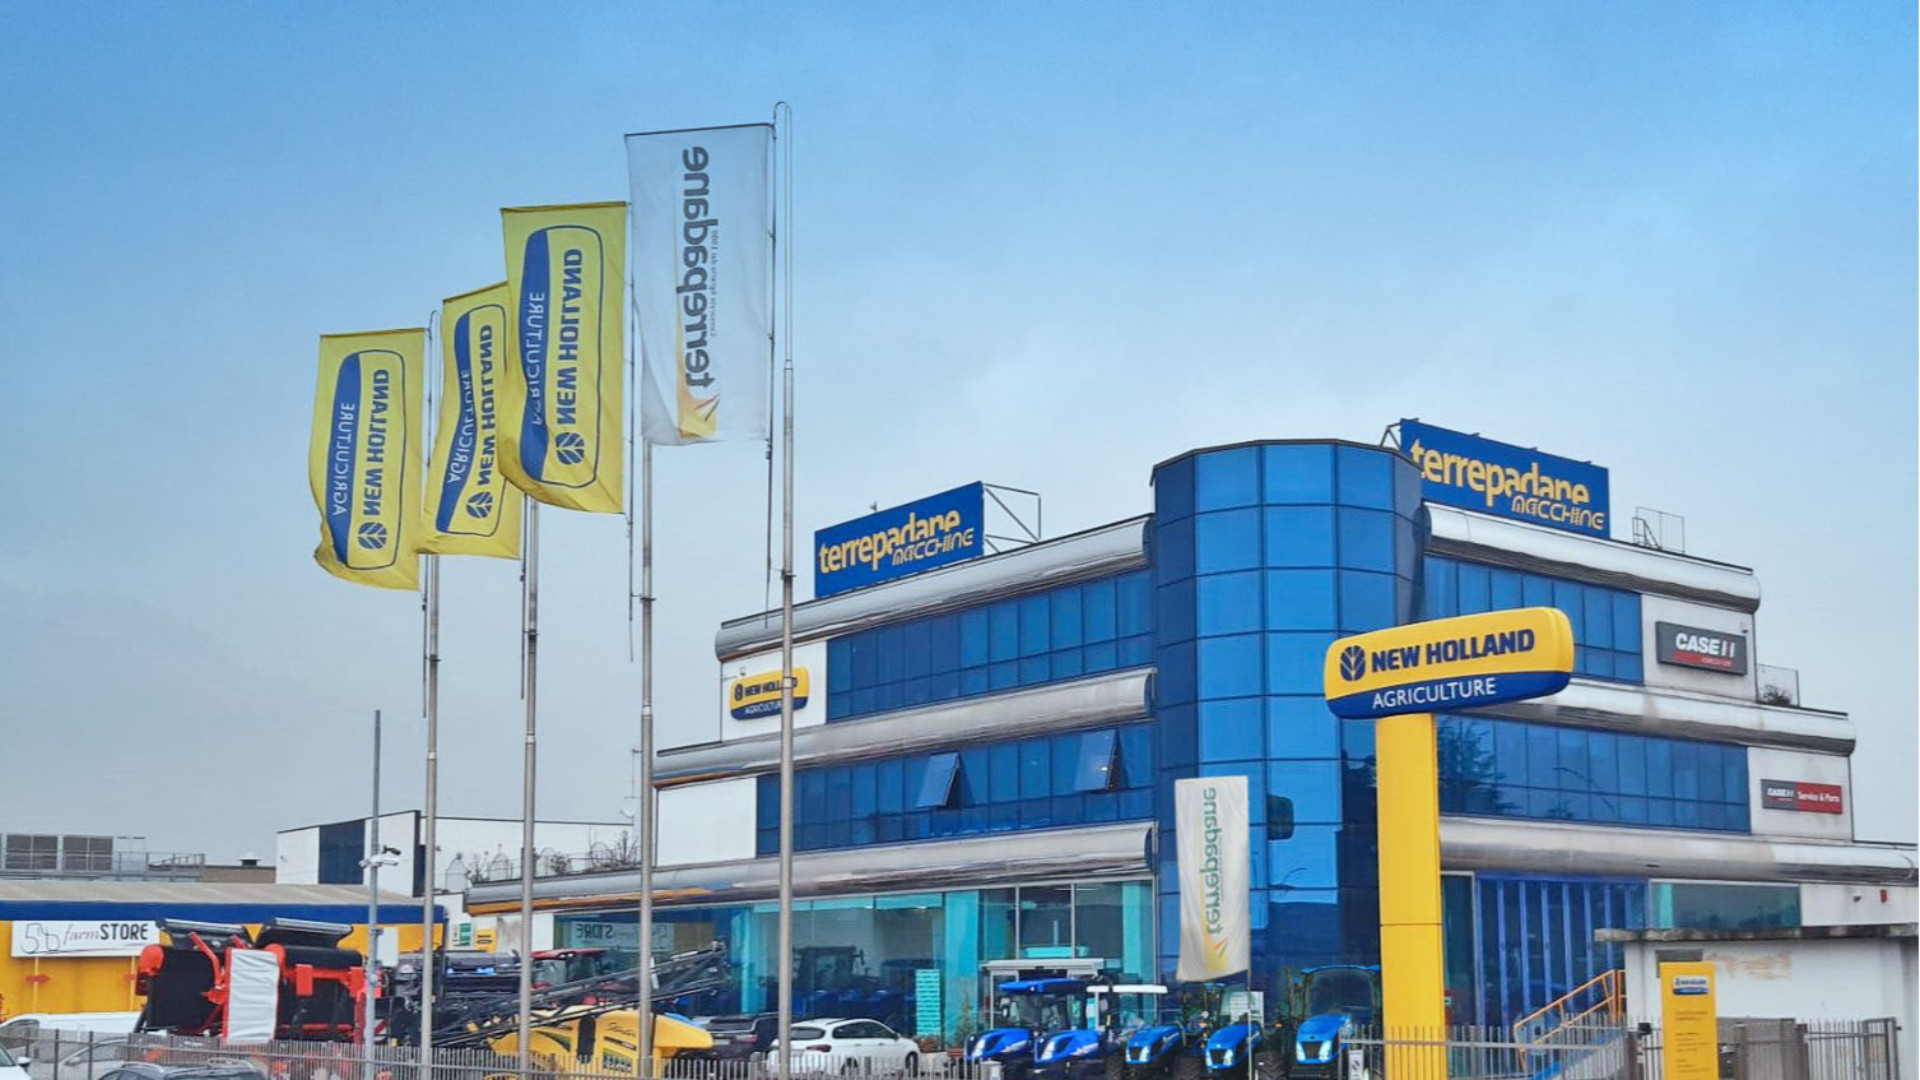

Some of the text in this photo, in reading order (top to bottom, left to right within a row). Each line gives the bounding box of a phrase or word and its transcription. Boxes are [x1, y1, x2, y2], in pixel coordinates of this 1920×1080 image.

[1410, 439, 1590, 507] terrepadane
[819, 510, 961, 574] terrepadane
[1372, 629, 1535, 673] NEW HOLLAND
[1676, 632, 1720, 655] CASE
[745, 683, 761, 696] NEW
[1372, 677, 1497, 709] AGRICULTURE
